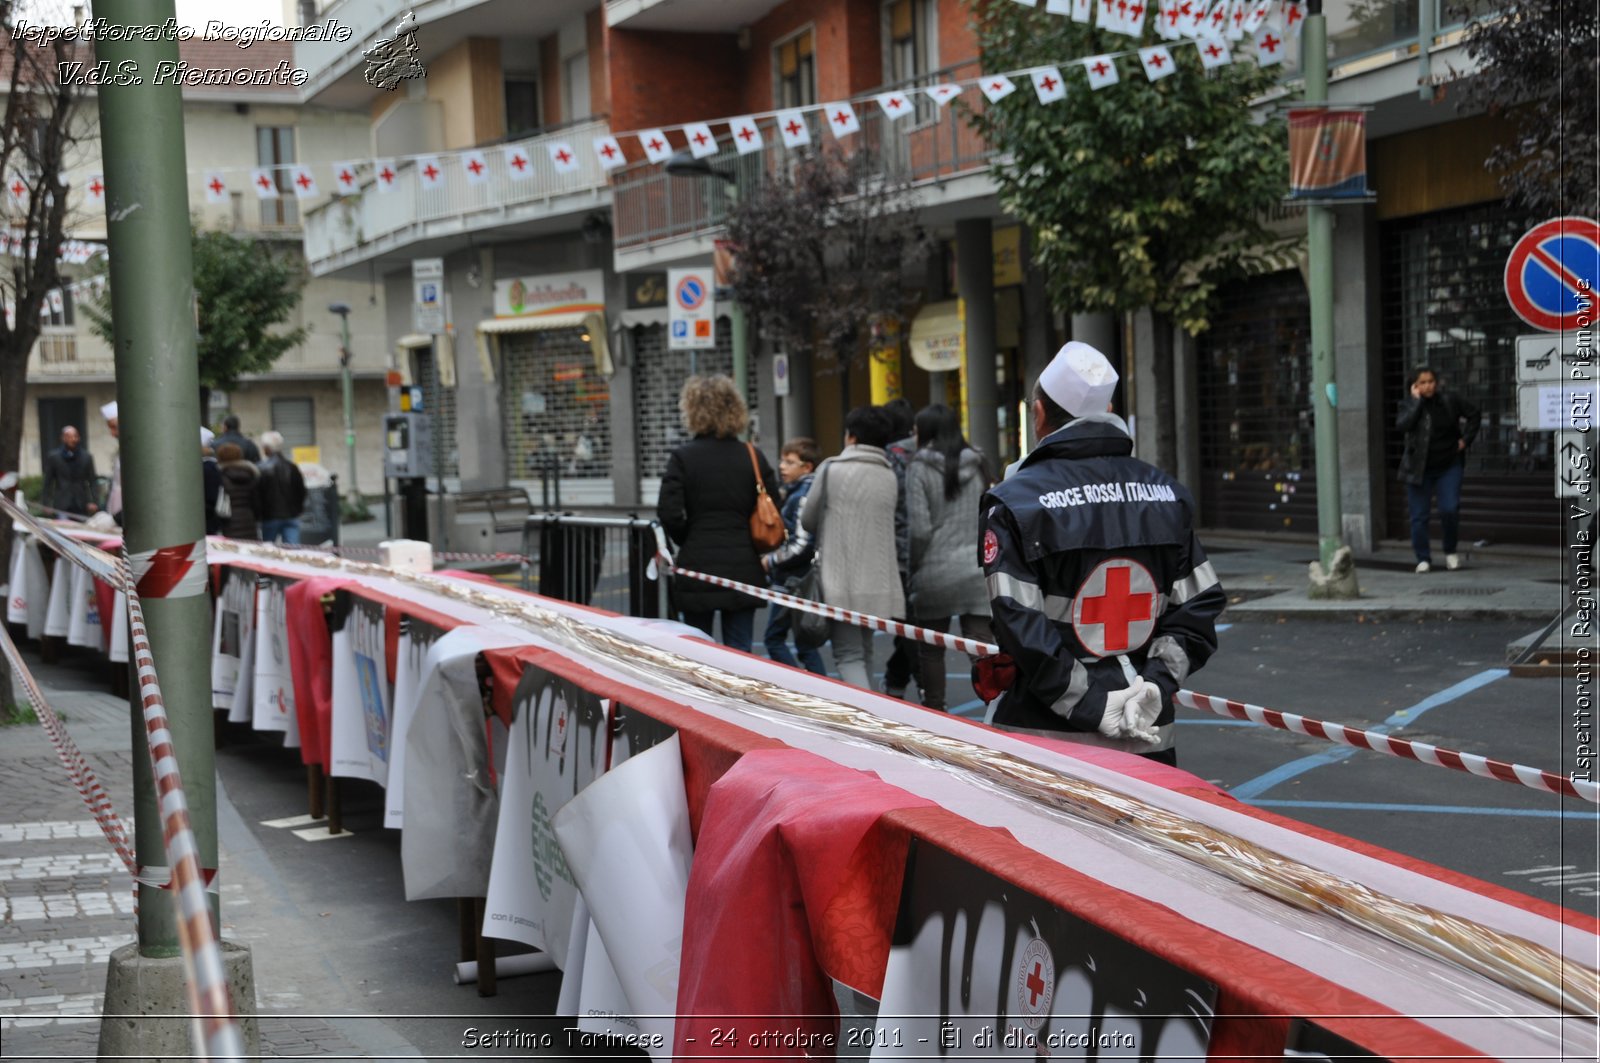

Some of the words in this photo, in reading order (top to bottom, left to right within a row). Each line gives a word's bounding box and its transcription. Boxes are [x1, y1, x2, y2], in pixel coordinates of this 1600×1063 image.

[1038, 487, 1086, 509] CROCE
[1082, 482, 1126, 504] ROSSA
[1125, 482, 1177, 502] ITALIANA
